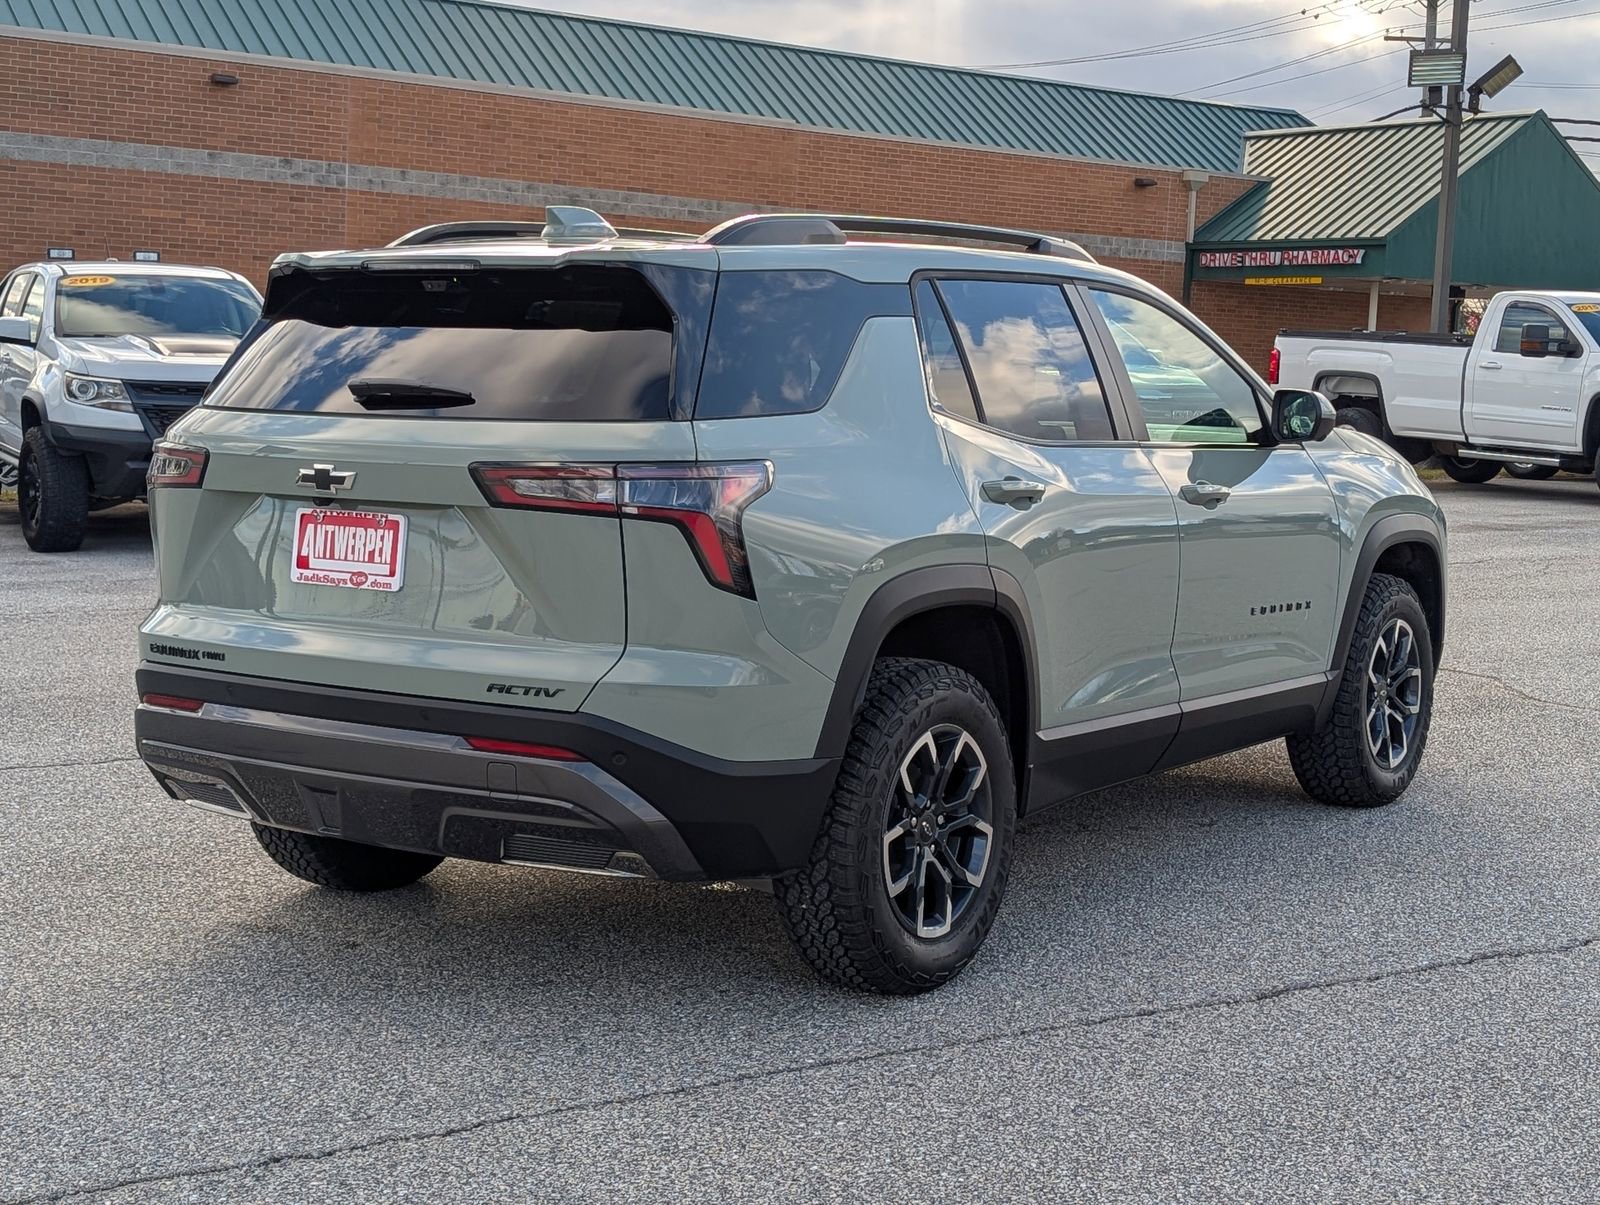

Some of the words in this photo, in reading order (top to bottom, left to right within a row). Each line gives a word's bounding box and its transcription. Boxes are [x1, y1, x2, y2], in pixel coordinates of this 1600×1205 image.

[1200, 252, 1241, 267] DRIVE
[1242, 251, 1280, 266] THRU
[1281, 249, 1364, 265] PHARMACY
[301, 523, 394, 564] ANTWERPEN
[1250, 600, 1312, 616] EQUINOX
[149, 643, 201, 660] EQUINOX
[486, 683, 566, 698] ACTIV
